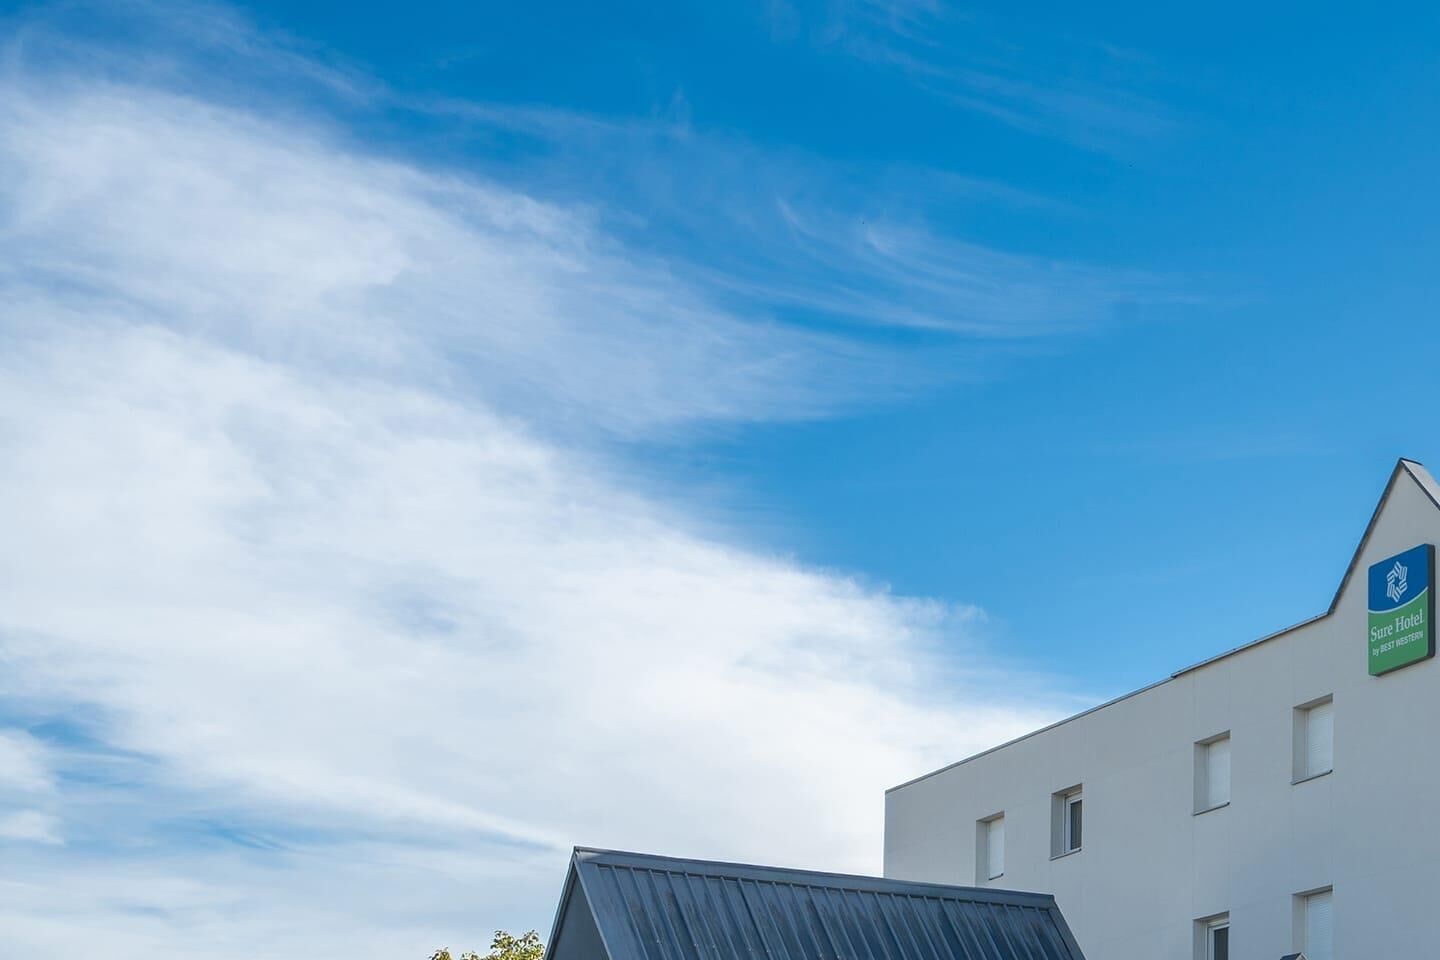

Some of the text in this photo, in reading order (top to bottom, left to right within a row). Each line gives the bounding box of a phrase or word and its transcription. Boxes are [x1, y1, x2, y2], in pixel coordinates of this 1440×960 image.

[1370, 608, 1424, 642] Sure Hotel
[1380, 640, 1395, 653] BEST
[1395, 630, 1424, 648] WESTERN
